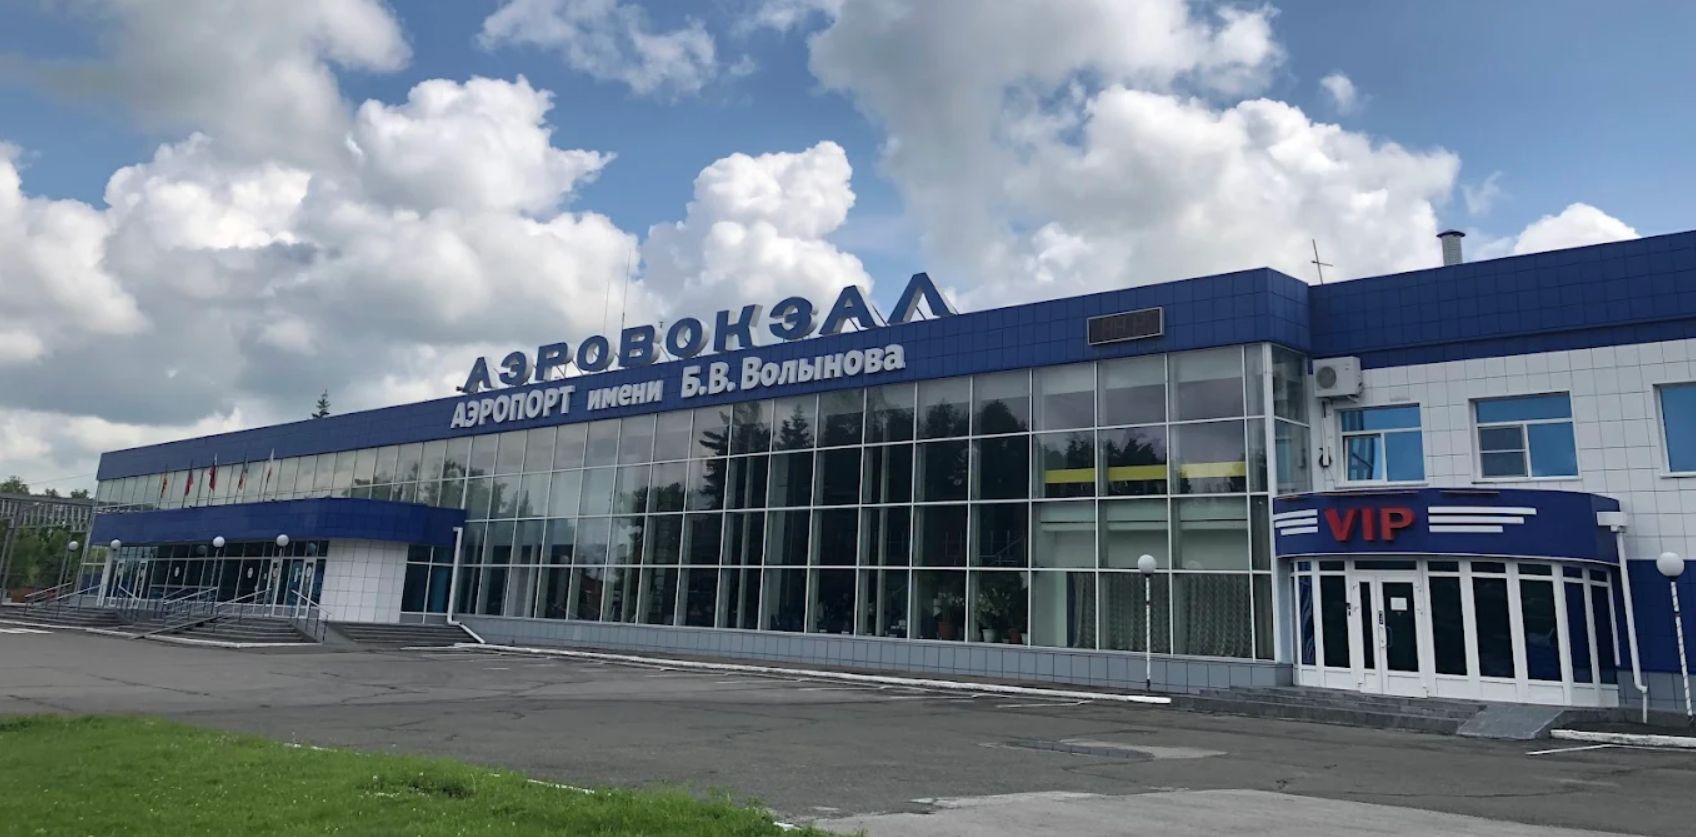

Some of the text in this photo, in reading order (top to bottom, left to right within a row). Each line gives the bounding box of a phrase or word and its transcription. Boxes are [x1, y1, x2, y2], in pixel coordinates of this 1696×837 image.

[461, 272, 957, 394] АЭРОВОКЗАЛ
[451, 386, 575, 429] АЭРОПОРТ
[587, 380, 663, 410] имени
[741, 344, 905, 390] Волынова
[1324, 507, 1415, 542] VIP
